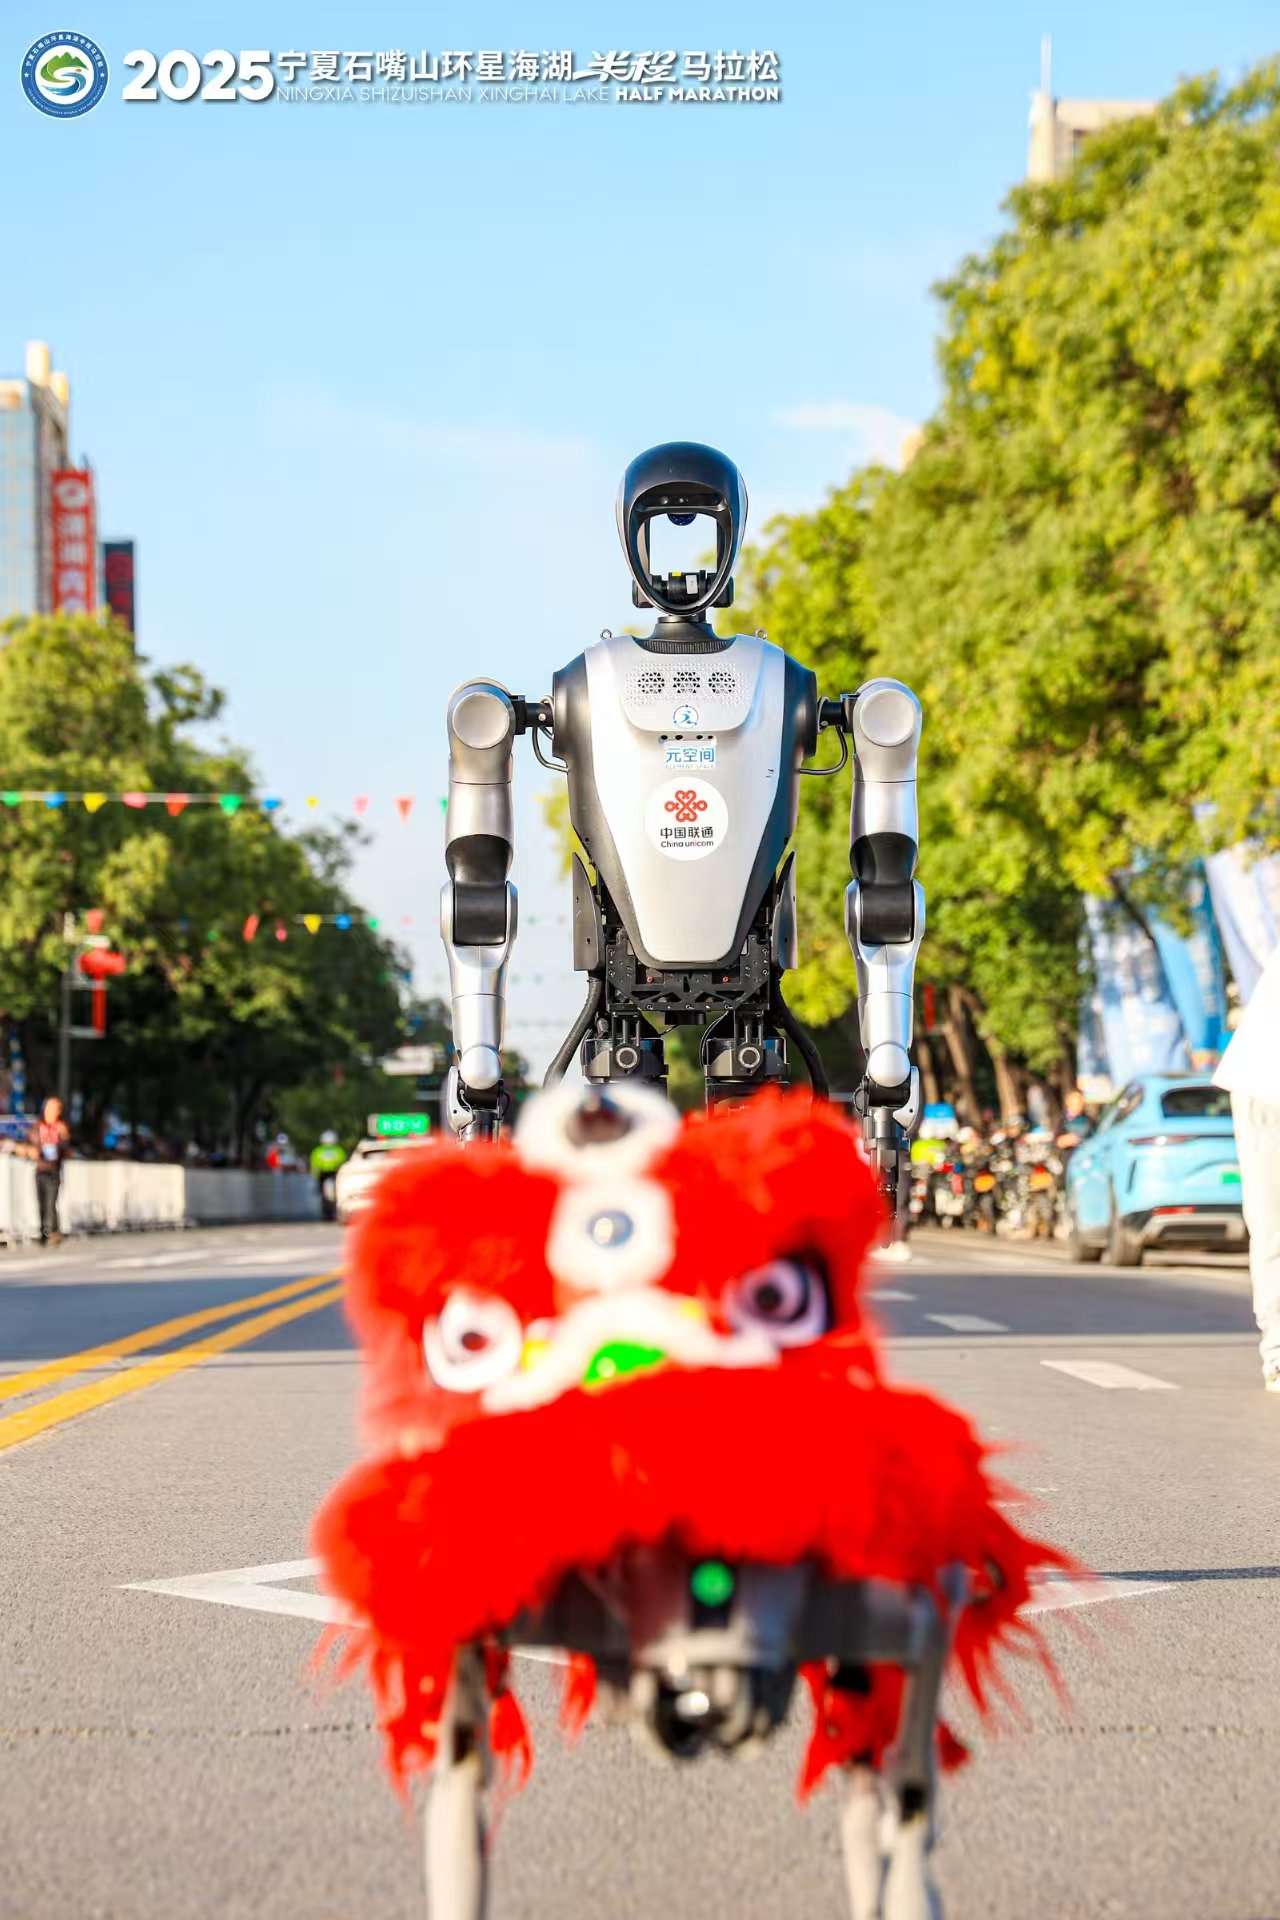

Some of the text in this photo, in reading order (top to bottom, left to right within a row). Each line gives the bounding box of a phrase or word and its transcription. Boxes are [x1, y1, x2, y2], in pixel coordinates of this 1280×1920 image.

[666, 747, 715, 763] 元空间
[660, 826, 714, 839] 中国联通
[660, 840, 714, 848] China unicom
